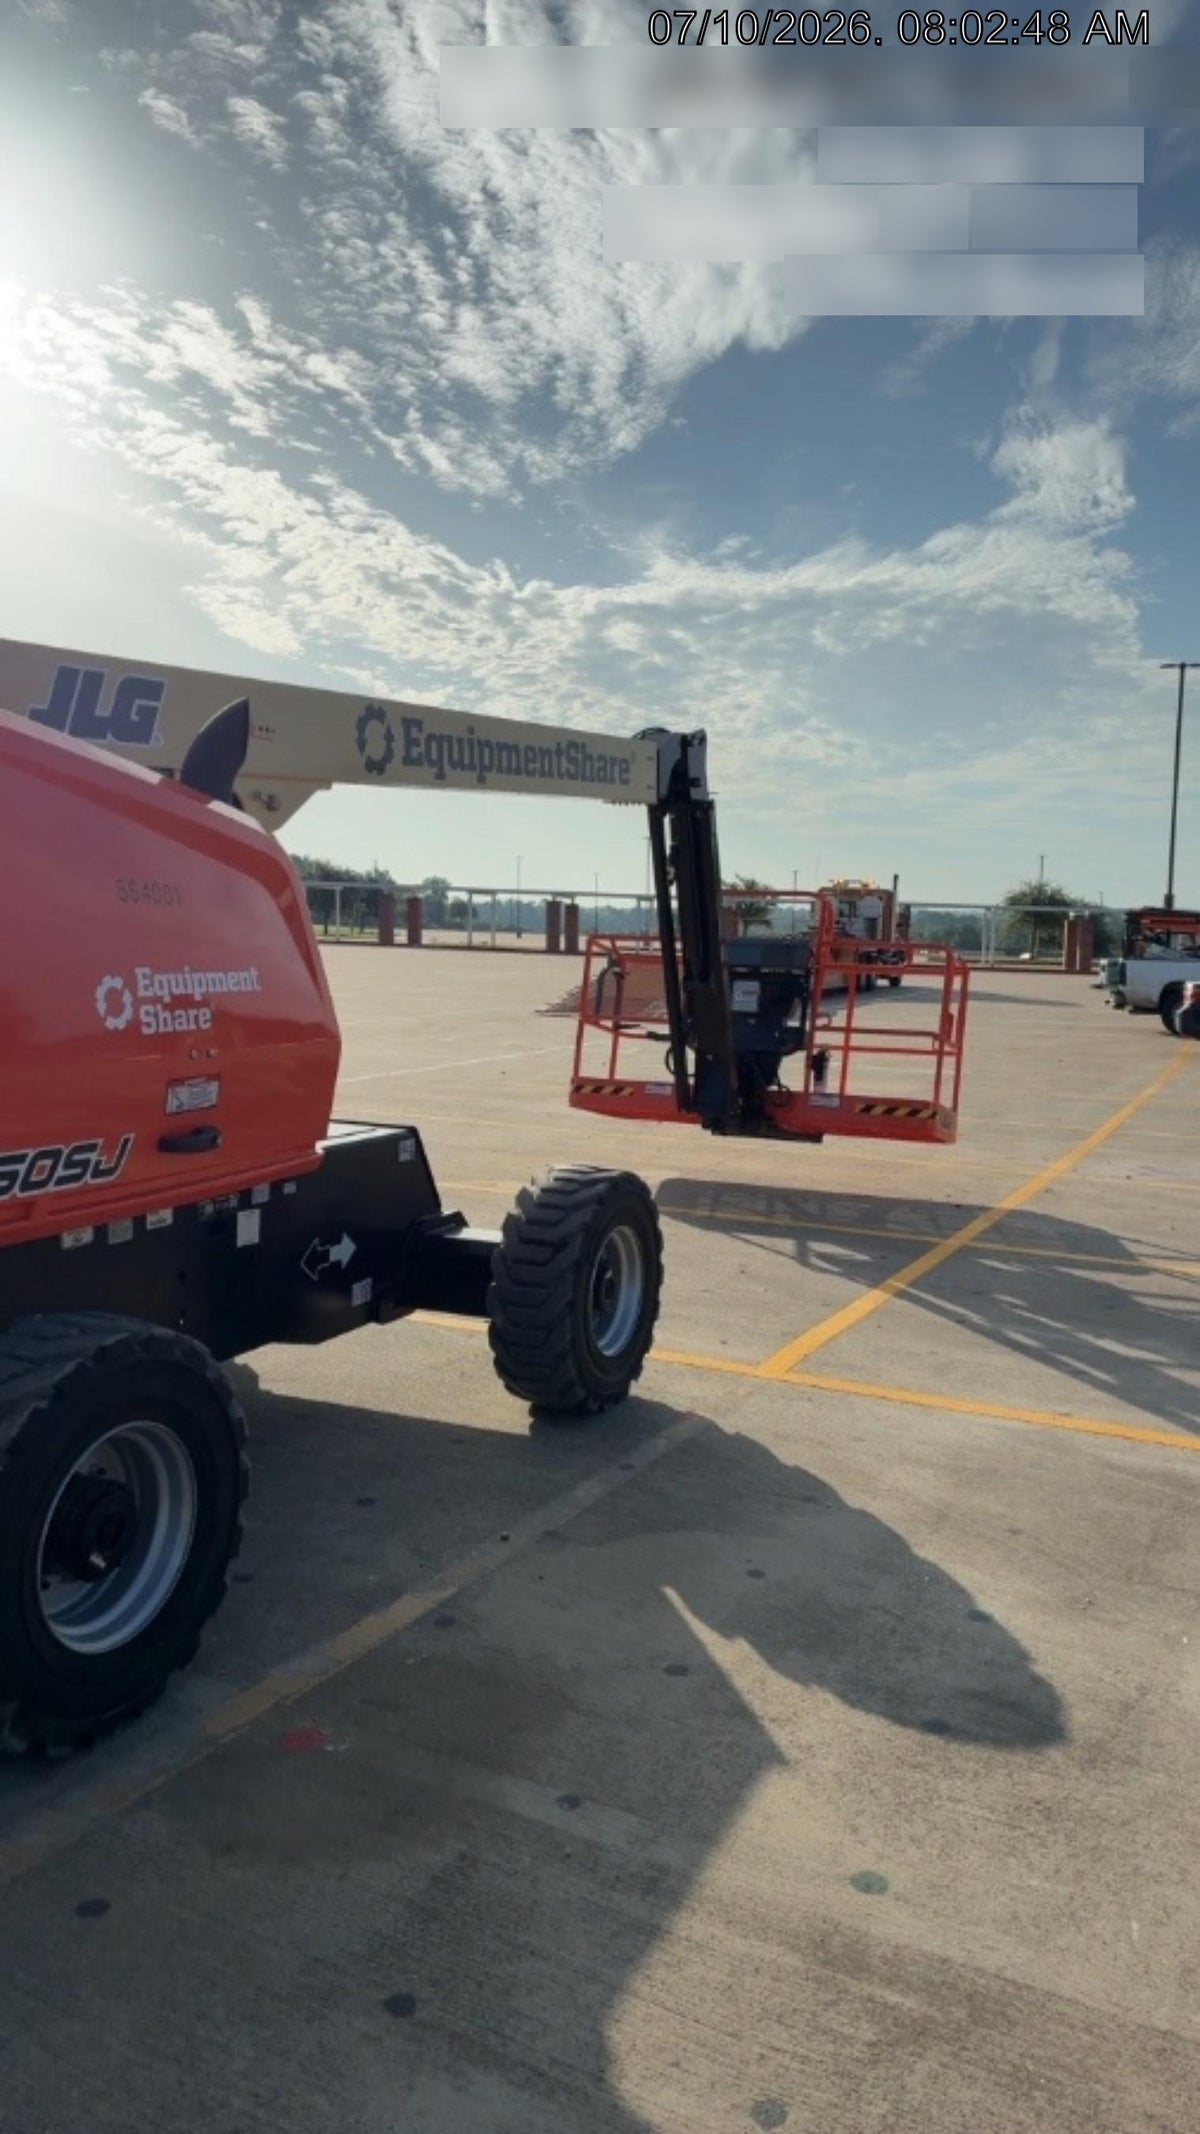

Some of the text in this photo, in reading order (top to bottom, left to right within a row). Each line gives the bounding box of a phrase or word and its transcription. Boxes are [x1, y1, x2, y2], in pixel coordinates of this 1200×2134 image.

[27, 662, 167, 747] JLG
[401, 717, 631, 786] EquipmentShare
[135, 965, 261, 1003] Equipment
[139, 1003, 212, 1035] Share
